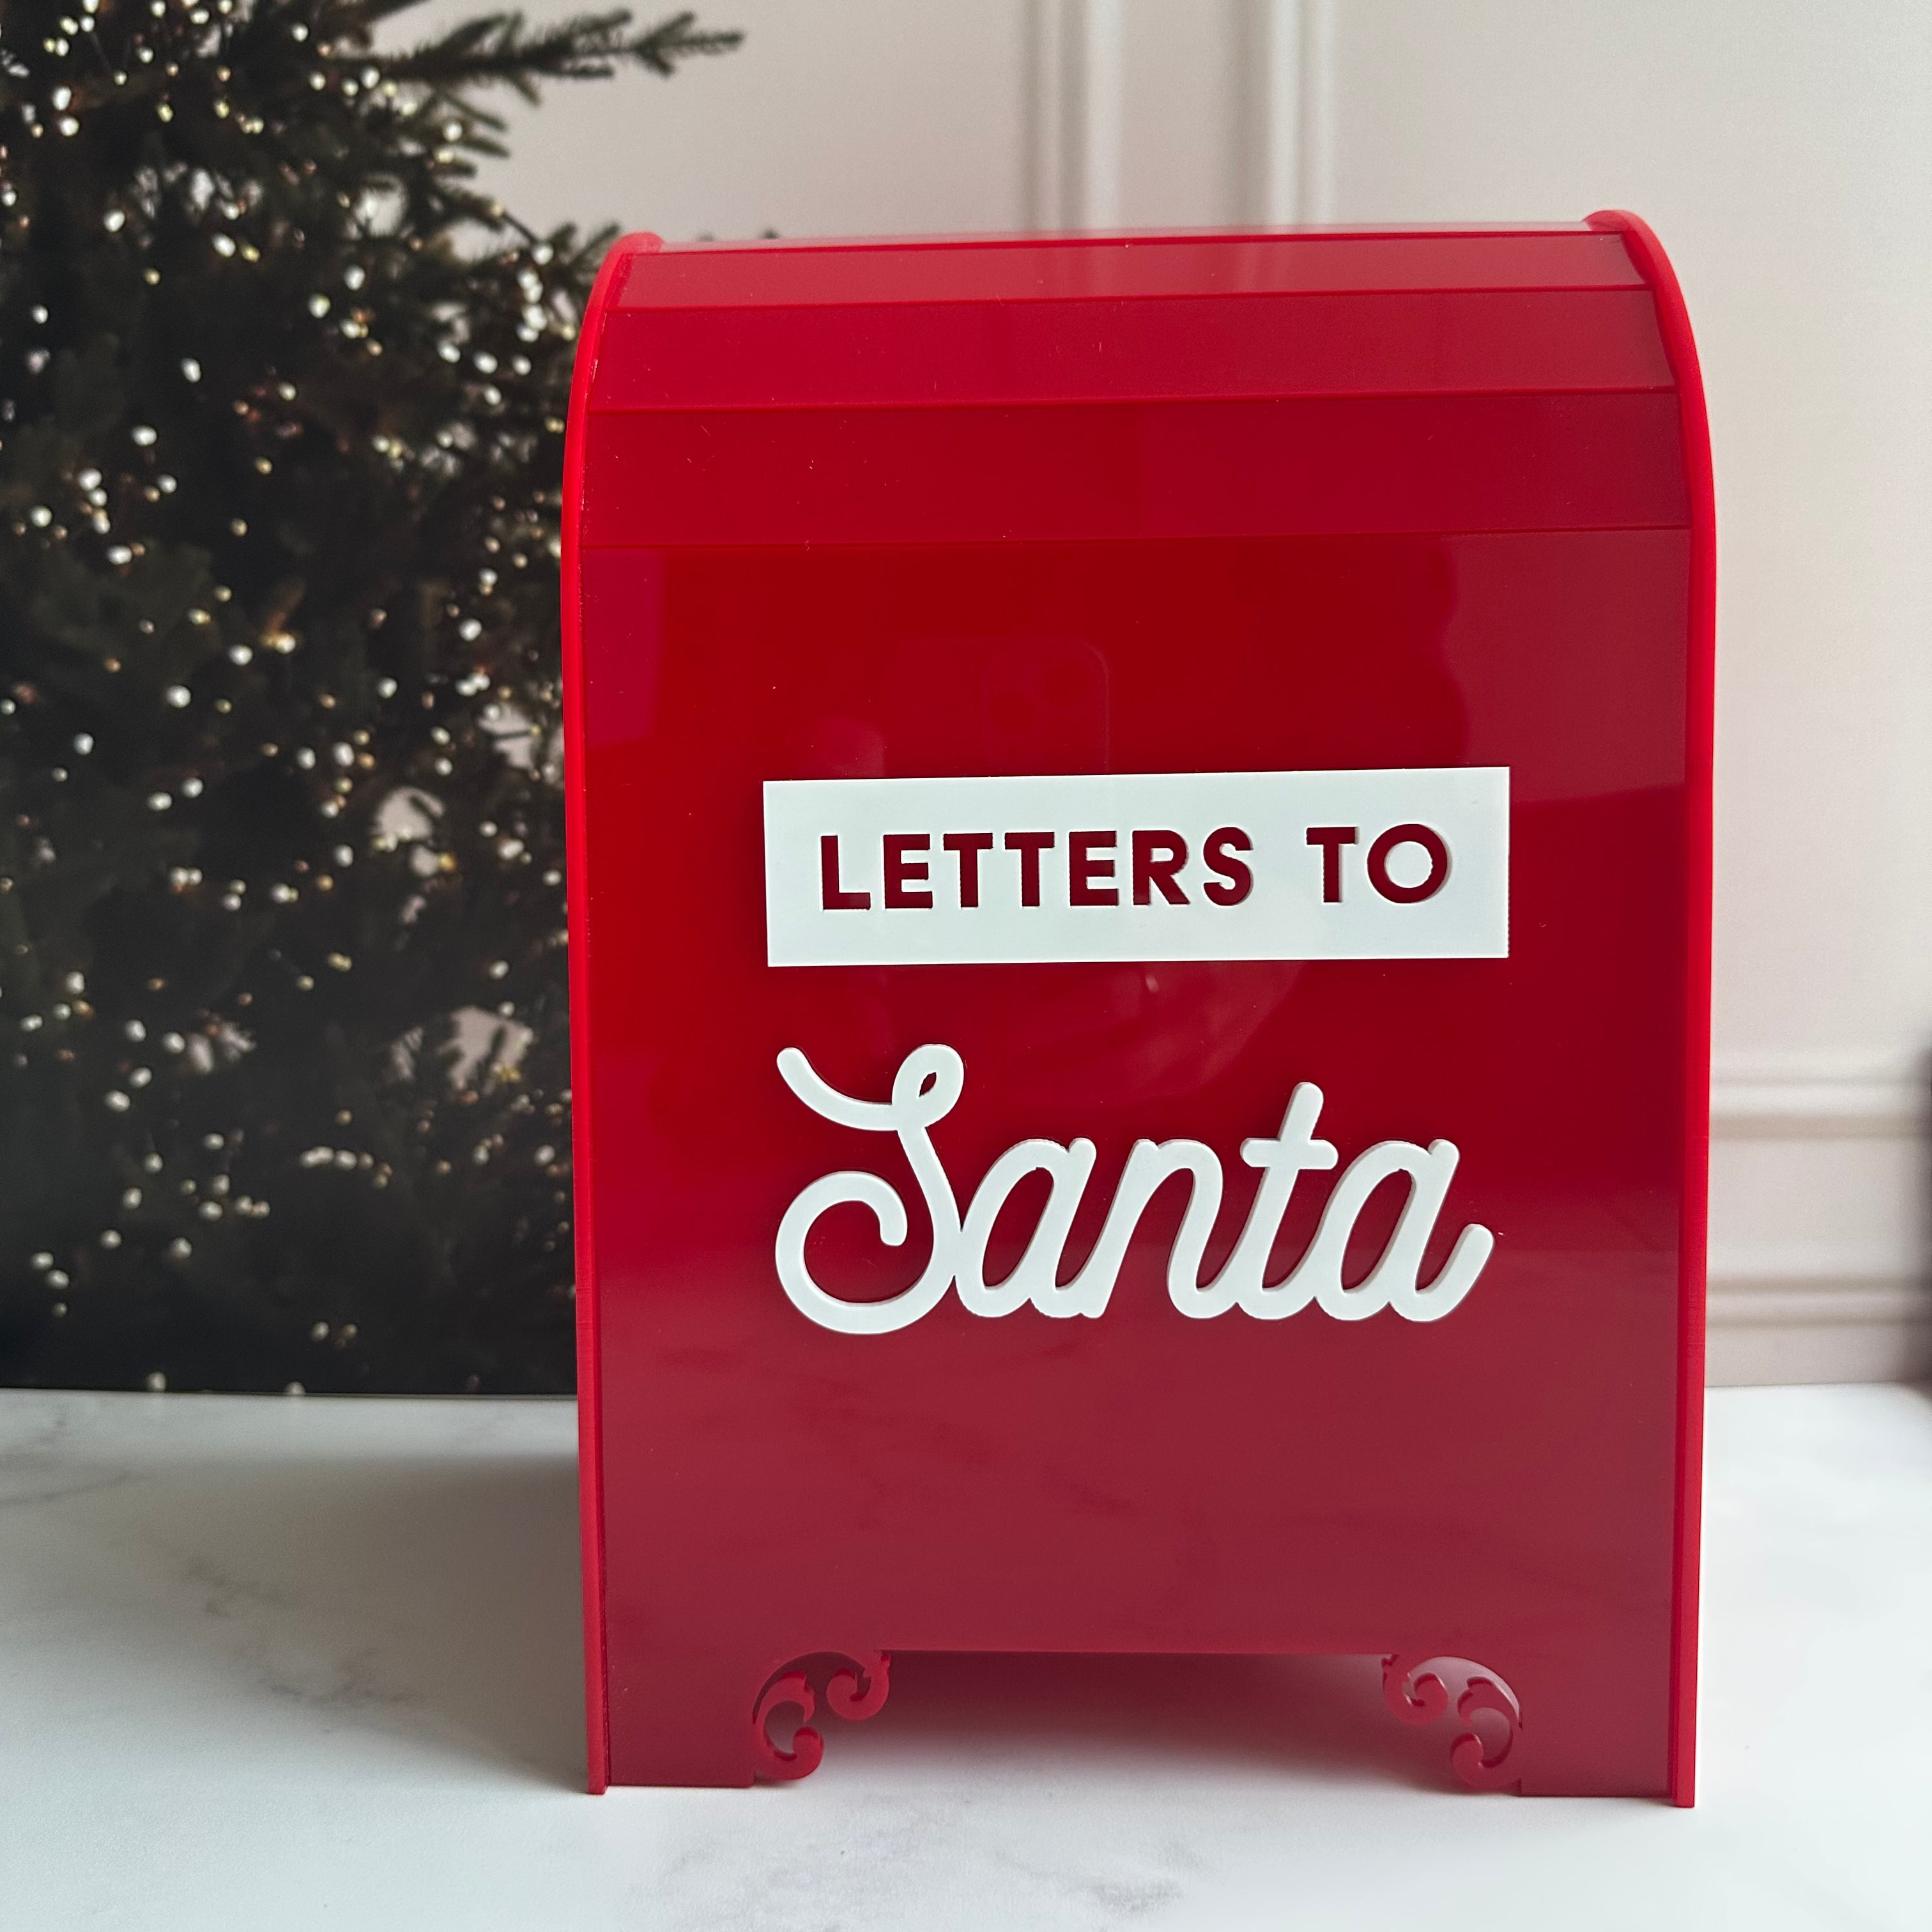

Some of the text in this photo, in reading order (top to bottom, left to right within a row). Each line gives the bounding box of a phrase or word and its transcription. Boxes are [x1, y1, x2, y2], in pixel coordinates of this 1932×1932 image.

[820, 824, 1450, 910] LETTERS TO
[775, 1043, 1494, 1335] Santa
